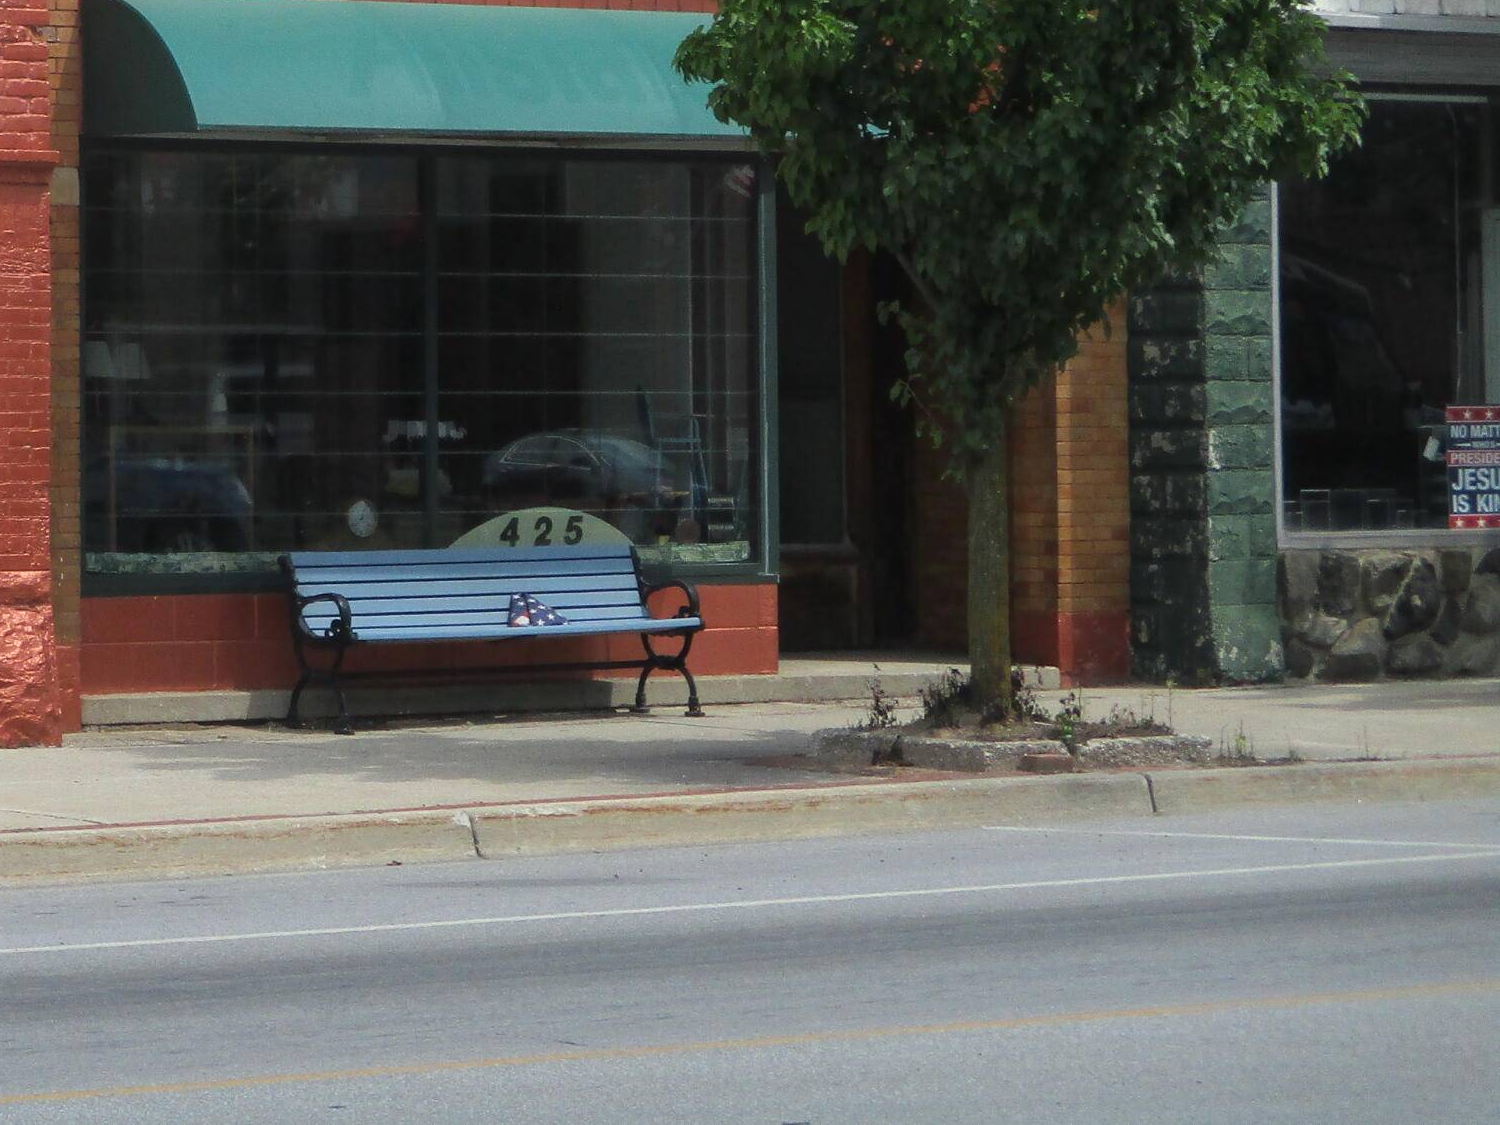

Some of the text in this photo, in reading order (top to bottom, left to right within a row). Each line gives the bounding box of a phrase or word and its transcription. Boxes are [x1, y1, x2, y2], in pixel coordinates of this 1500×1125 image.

[1450, 425, 1467, 438] NO
[1452, 494, 1470, 513] IS
[500, 515, 584, 547] 425
